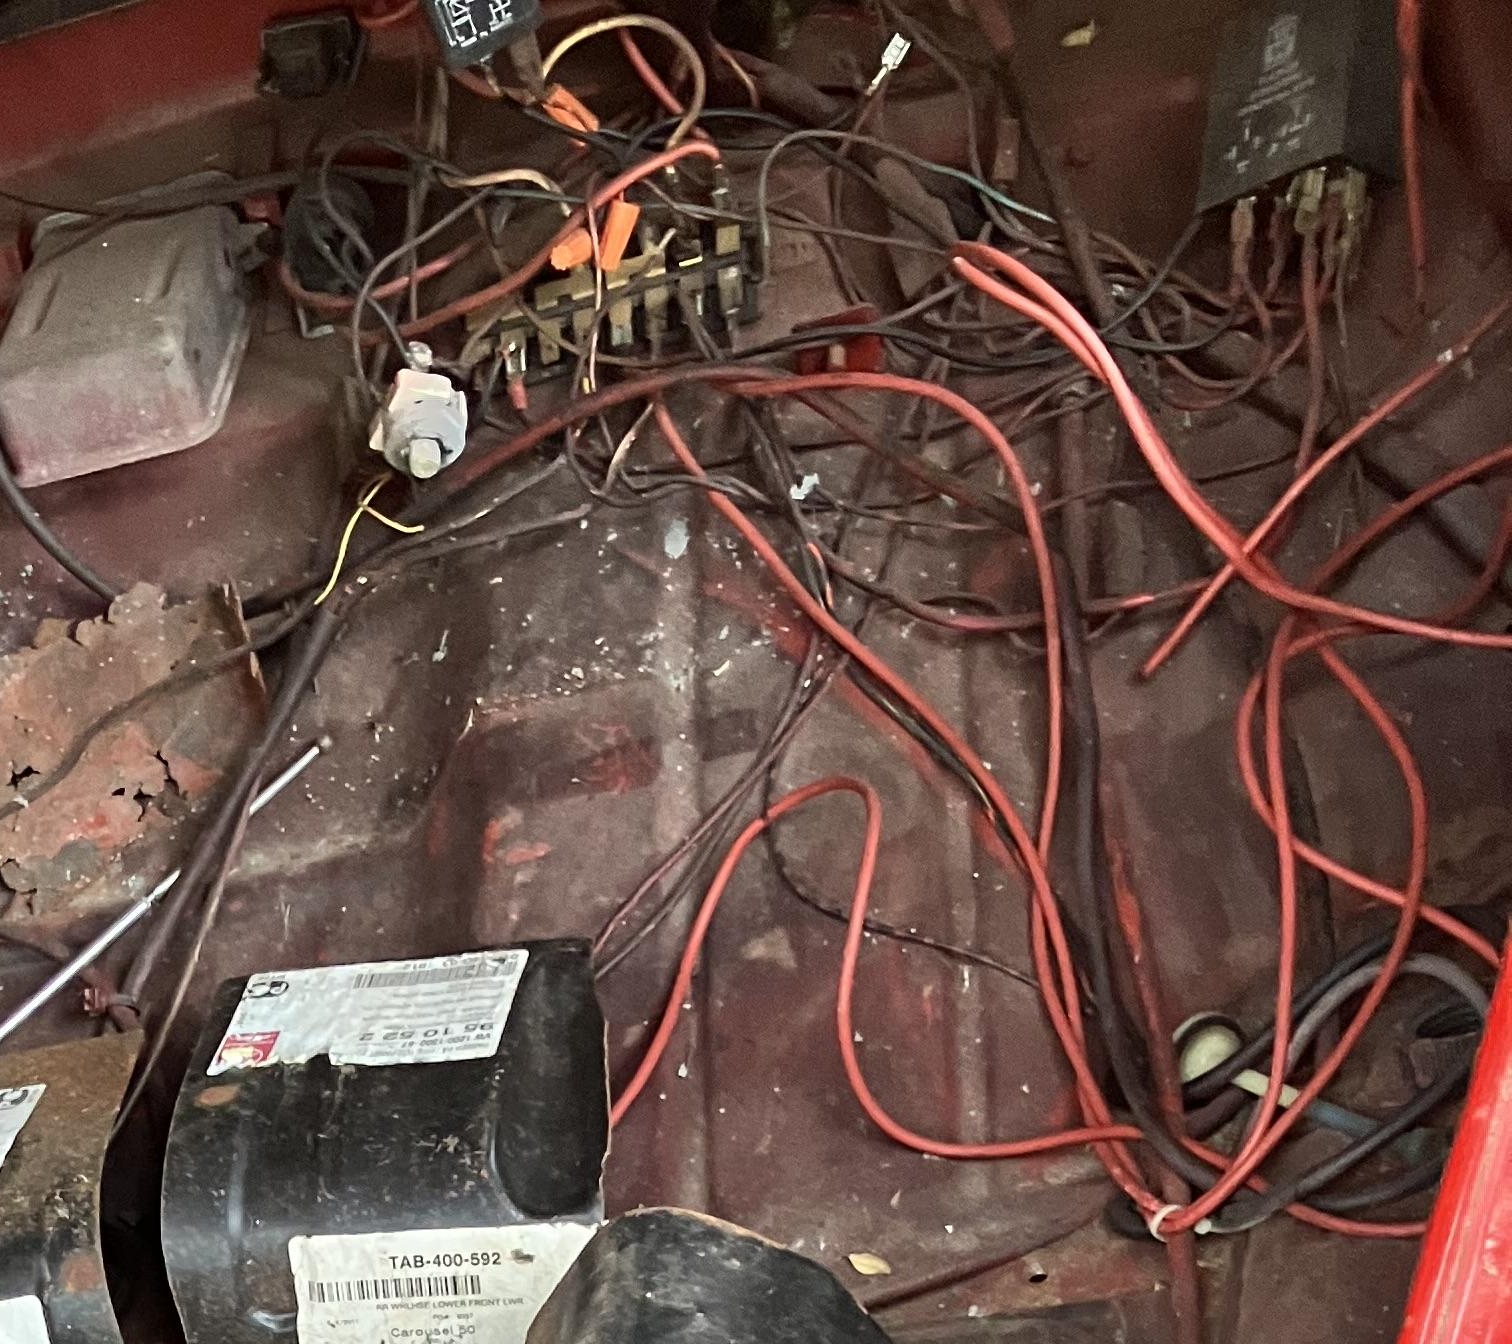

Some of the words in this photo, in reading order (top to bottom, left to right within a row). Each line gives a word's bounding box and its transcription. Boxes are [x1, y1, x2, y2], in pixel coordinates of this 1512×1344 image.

[422, 1027, 451, 1036] 10
[463, 1022, 494, 1032] 95
[390, 1251, 501, 1269] TAB-400-592
[432, 1300, 465, 1308] LOWER
[469, 1298, 501, 1306] FRONT
[391, 1325, 453, 1337] Carousel
